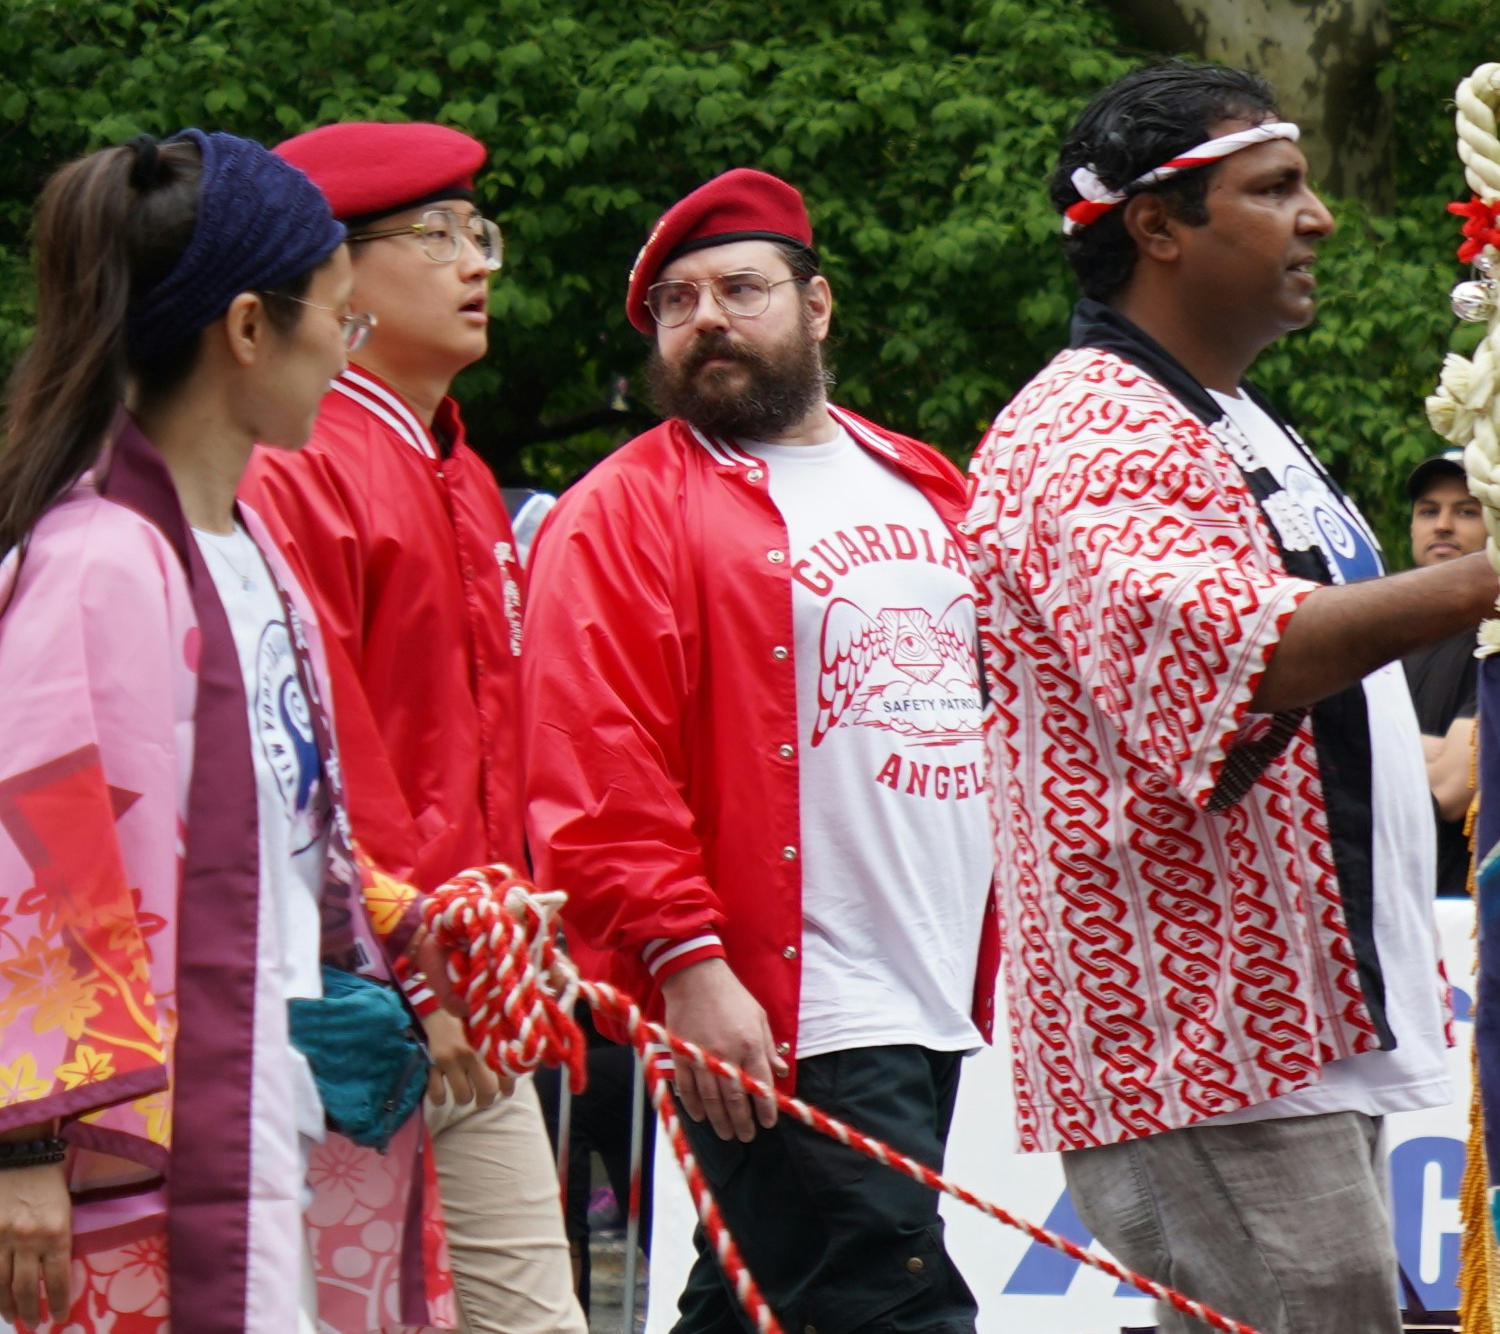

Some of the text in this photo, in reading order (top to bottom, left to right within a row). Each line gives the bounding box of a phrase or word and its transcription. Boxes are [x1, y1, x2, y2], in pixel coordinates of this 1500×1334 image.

[790, 522, 967, 598] GUARDIA
[882, 697, 981, 713] SAFETY PATROL
[874, 752, 985, 801] ANGEL
